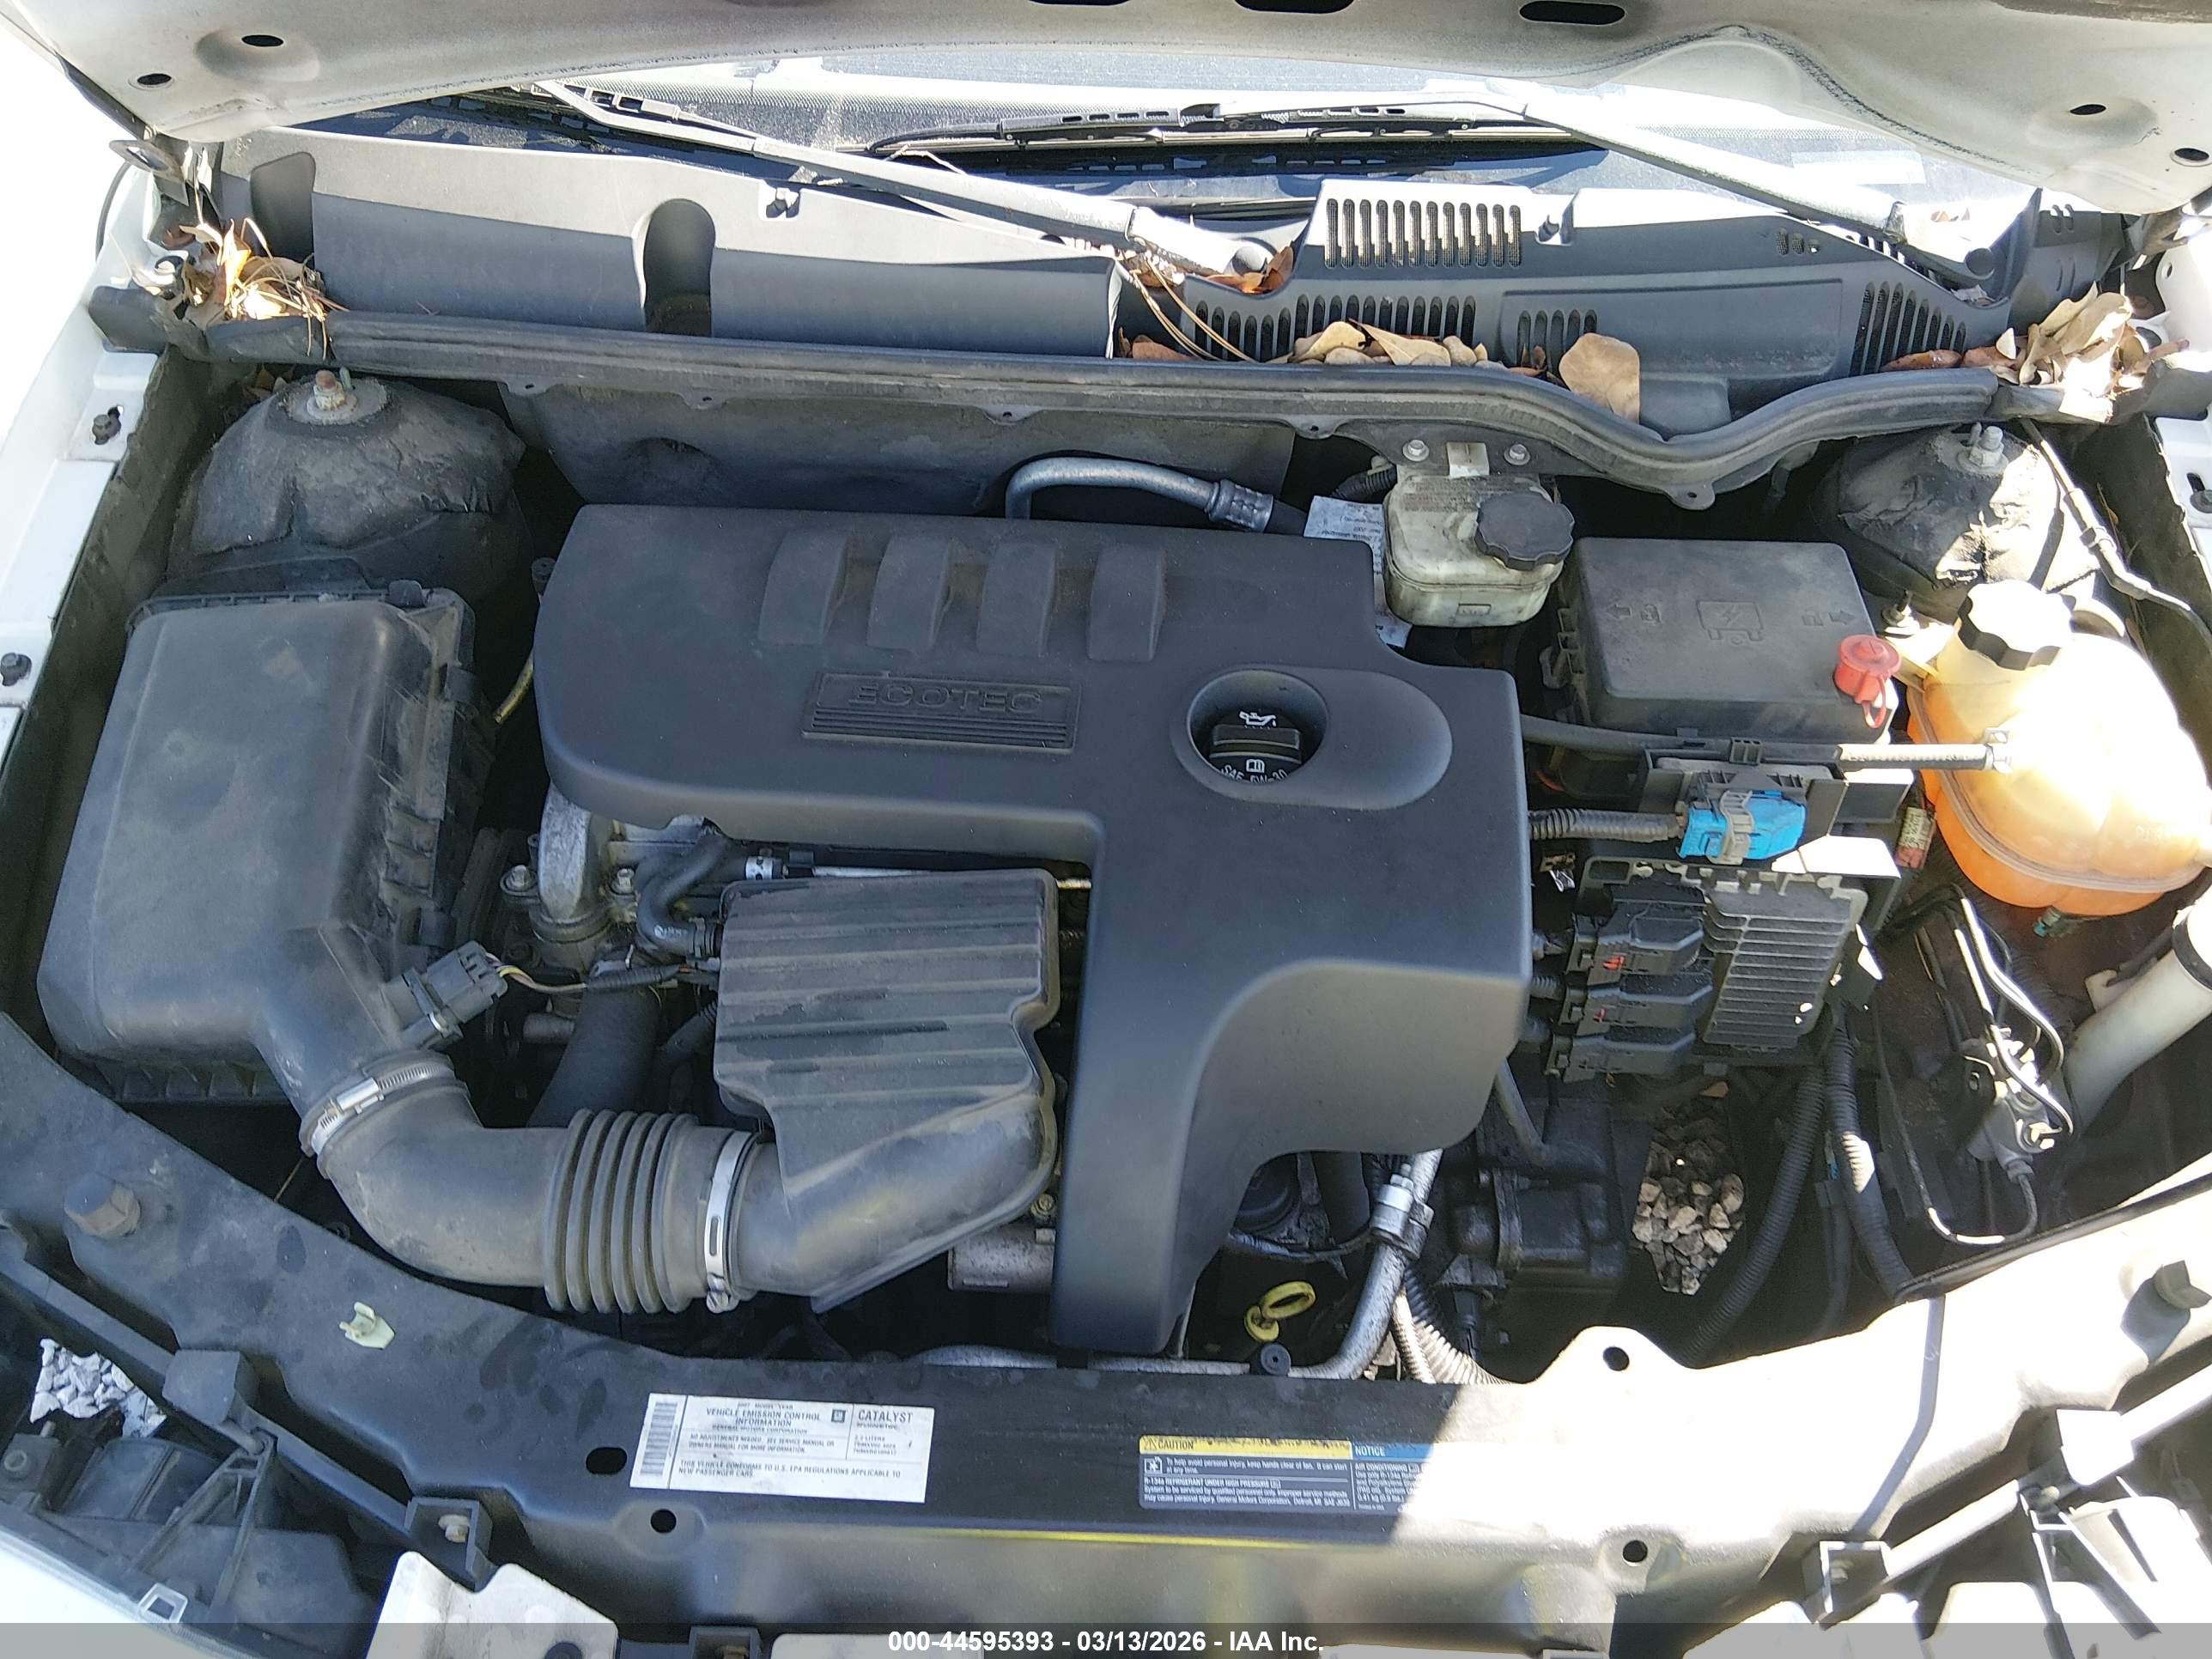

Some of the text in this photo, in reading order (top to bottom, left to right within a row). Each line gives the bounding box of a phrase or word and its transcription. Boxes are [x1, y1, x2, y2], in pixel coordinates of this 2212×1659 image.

[848, 685, 1043, 714] ECOTEC
[707, 1407, 739, 1417] VEHICLE
[742, 1409, 781, 1419] EMISSION
[784, 1412, 820, 1421] CONTROL
[858, 1409, 914, 1424] CATALYST
[735, 1416, 792, 1426] INFORMATION
[1158, 1440, 1194, 1450] CAUTION
[1355, 1445, 1386, 1456] NOTICE
[697, 1460, 724, 1468] VEHICLE
[726, 1462, 762, 1470] CONFORMS
[790, 1464, 802, 1473] EPA
[804, 1466, 850, 1475] REGULATIONS
[851, 1468, 890, 1477] APPLICABLE
[1366, 1463, 1408, 1472] CONDITIONING
